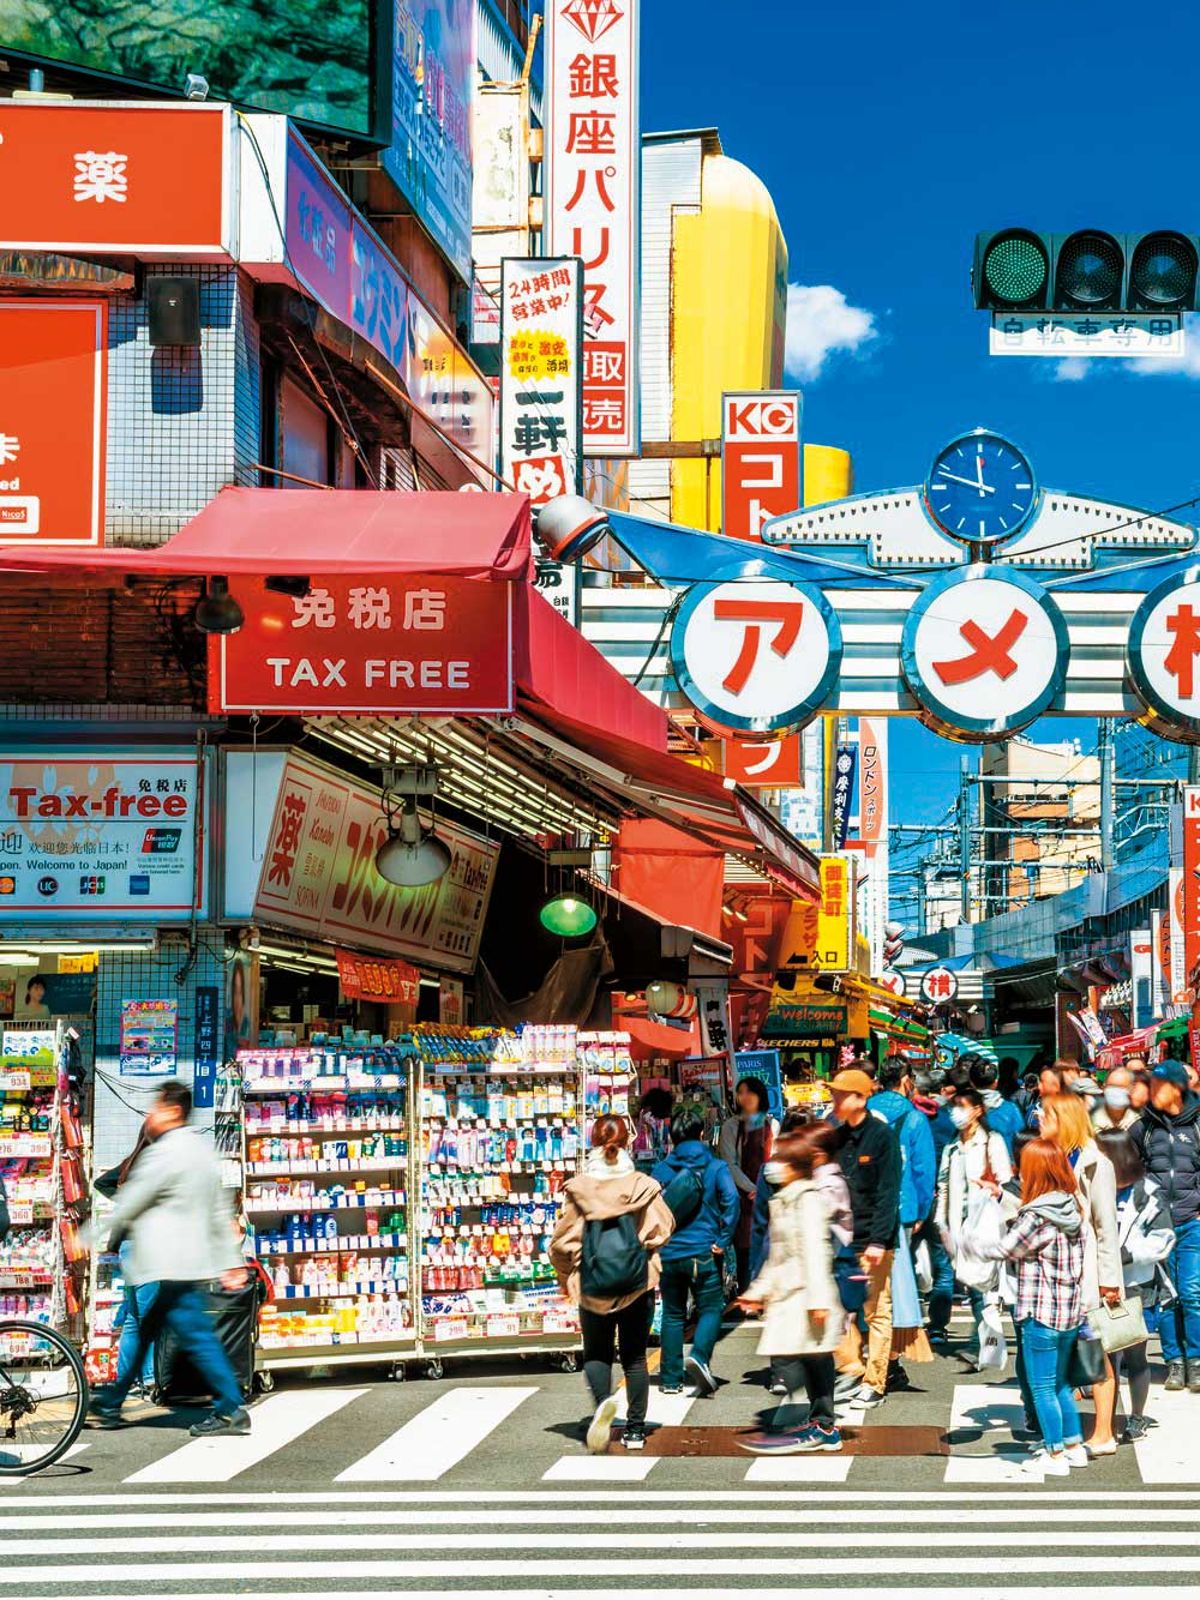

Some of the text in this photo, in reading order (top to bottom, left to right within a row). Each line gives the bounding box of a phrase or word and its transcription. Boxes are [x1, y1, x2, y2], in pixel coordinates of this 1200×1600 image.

[73, 150, 128, 203] 薬
[508, 268, 571, 300] 24時間
[1003, 317, 1173, 347] 自転車専用
[729, 403, 794, 435] KG
[291, 586, 446, 630] 免税店
[266, 658, 470, 689] TAX FREE
[139, 779, 187, 792] 免税店
[864, 746, 876, 796] ロンドン
[9, 787, 187, 817] Tax-free
[27, 860, 76, 870] Welcome
[79, 861, 89, 870] to
[93, 860, 127, 871] Japan!
[811, 951, 837, 963] 入口
